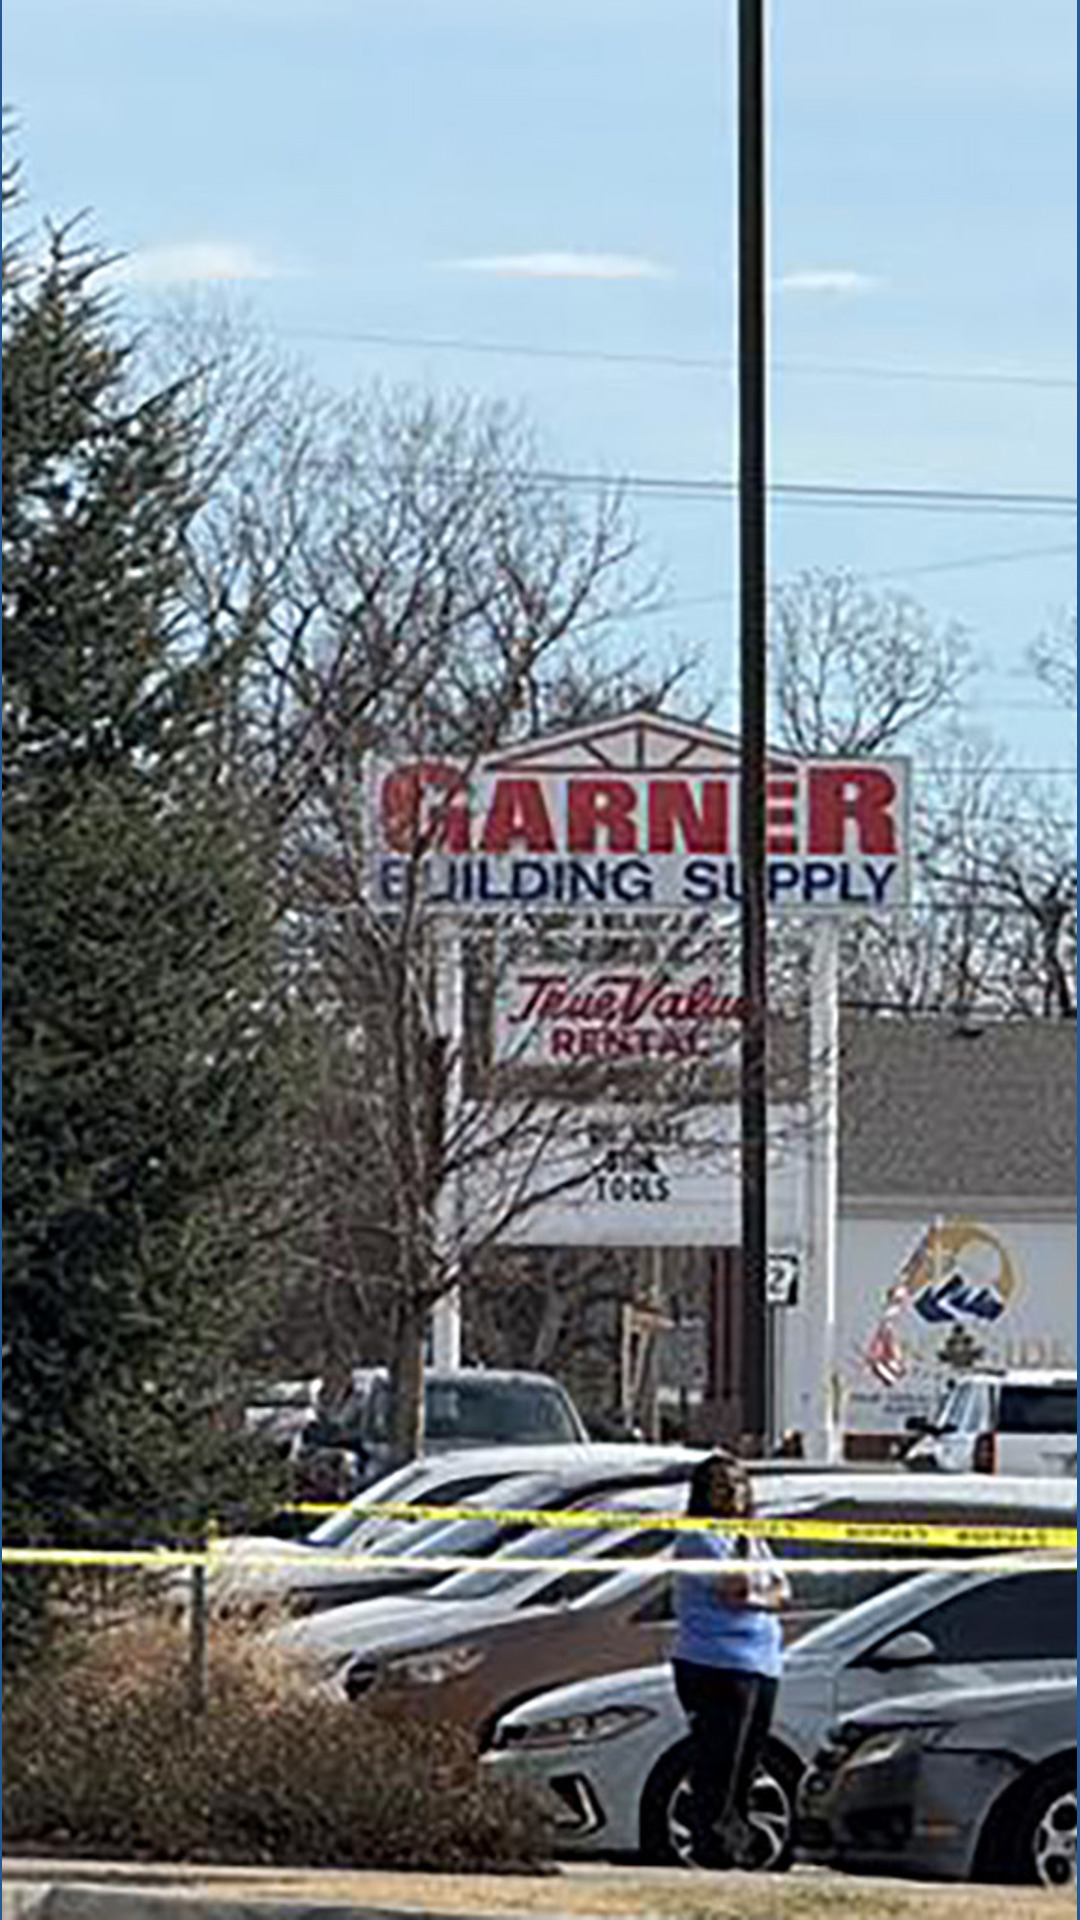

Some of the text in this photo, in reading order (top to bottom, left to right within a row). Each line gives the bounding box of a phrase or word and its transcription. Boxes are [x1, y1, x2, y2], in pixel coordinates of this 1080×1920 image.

[380, 763, 898, 855] GARNER
[380, 859, 653, 901] BUILDING
[594, 974, 752, 1024] Valu
[551, 1029, 711, 1057] RENTAL
[597, 1176, 671, 1202] TOOLS
